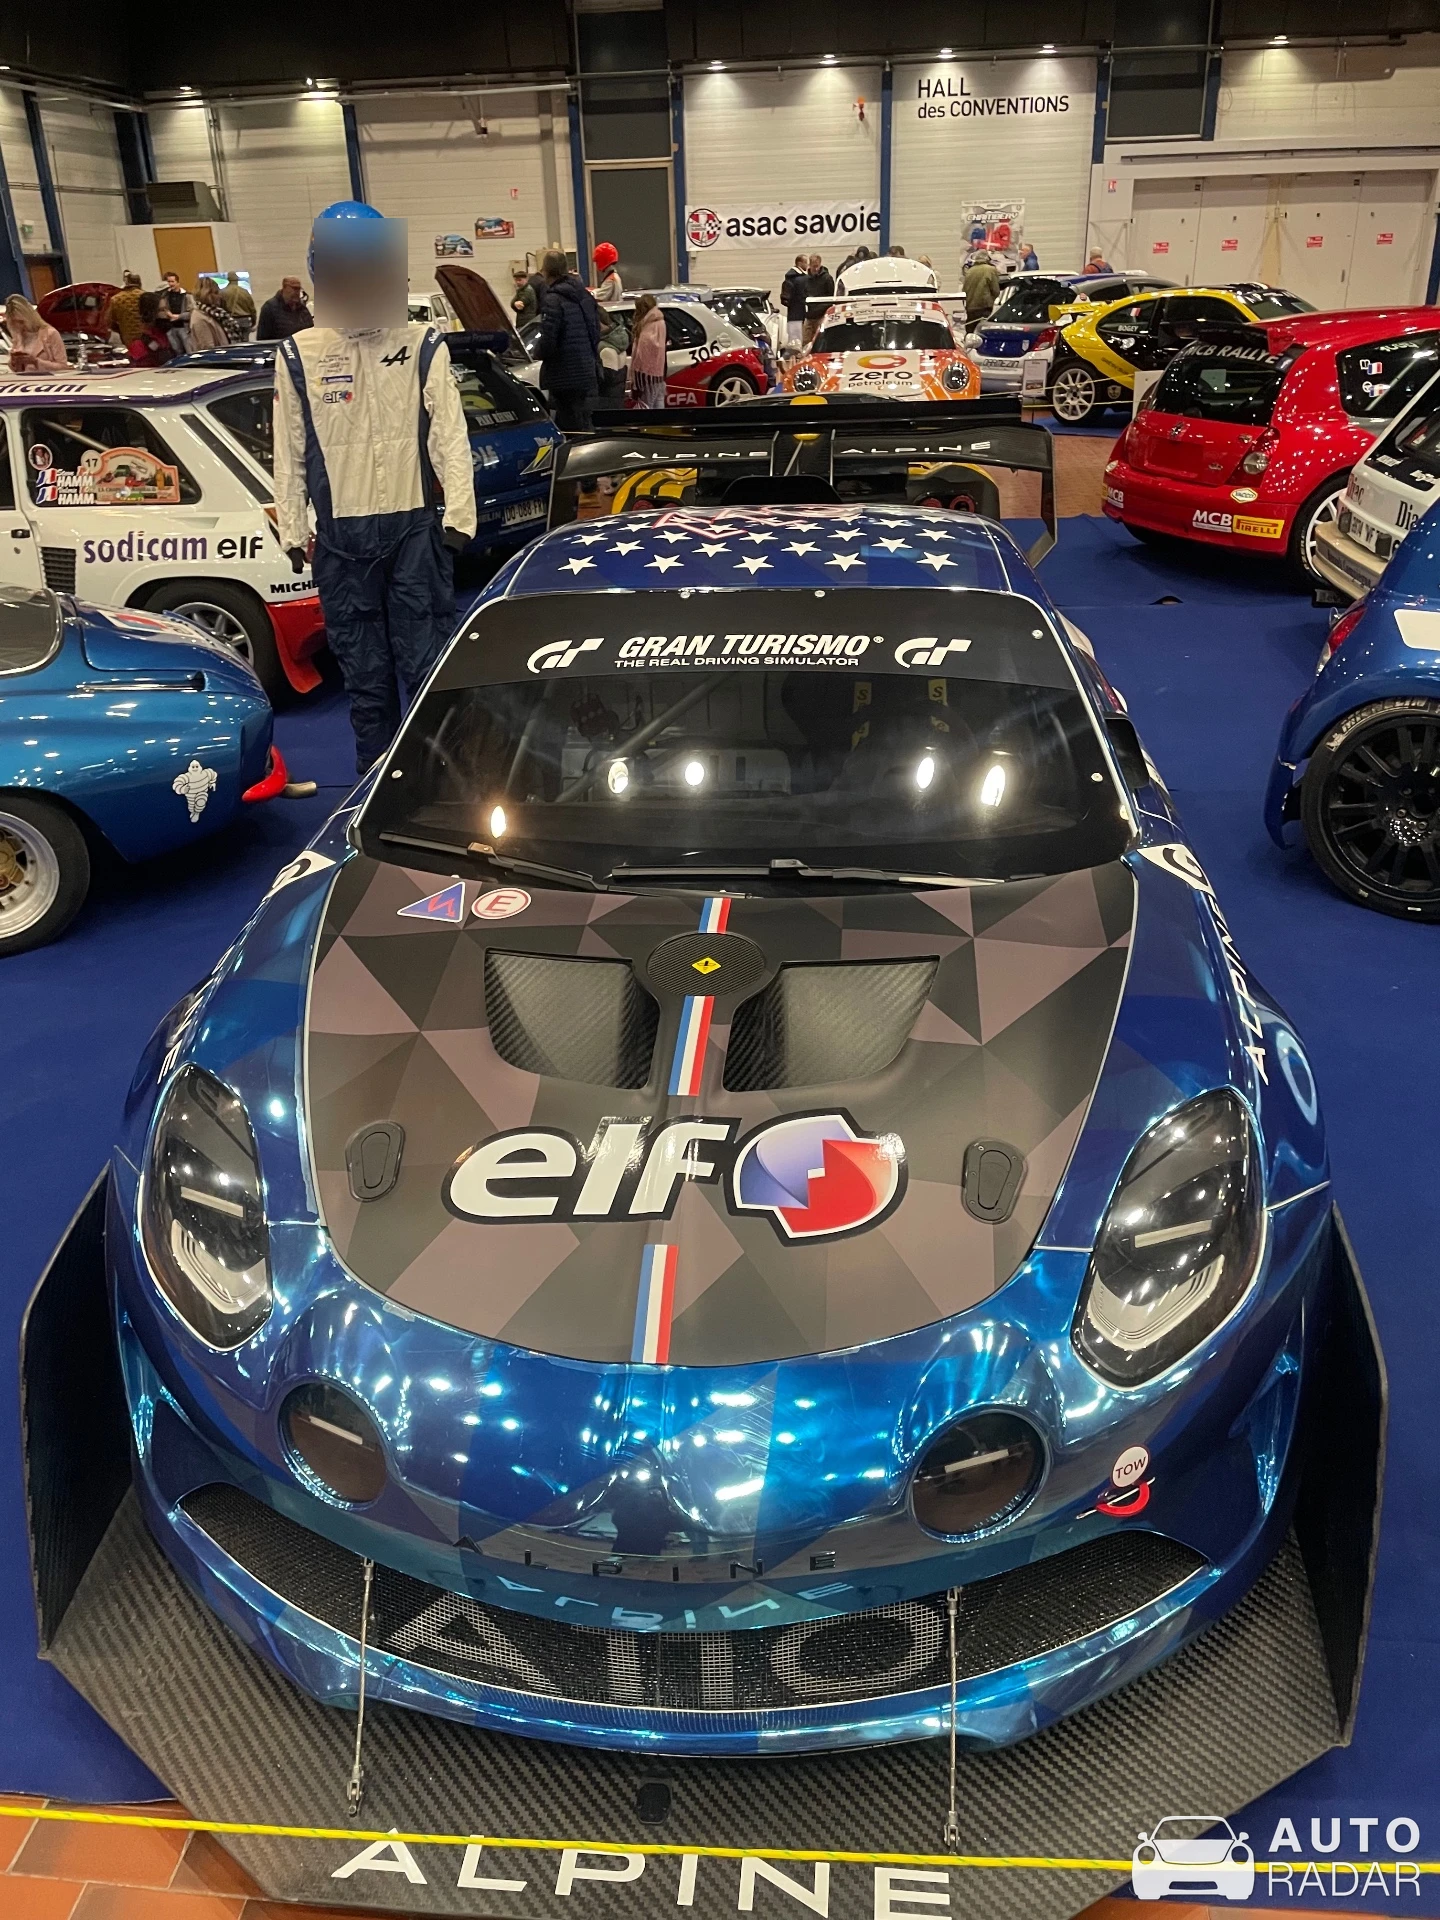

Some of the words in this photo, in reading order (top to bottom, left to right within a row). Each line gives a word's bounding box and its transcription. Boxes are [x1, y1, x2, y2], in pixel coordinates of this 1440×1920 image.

[917, 77, 971, 98] HALL
[918, 102, 946, 118] des
[950, 95, 1070, 117] CONVENTIONS
[725, 216, 787, 237] asac
[794, 205, 880, 235] savoie
[688, 340, 720, 369] 306
[1216, 345, 1284, 364] RALLYE
[848, 371, 913, 382] zero
[848, 380, 913, 388] petroleum
[322, 390, 341, 404] elf
[666, 392, 698, 406] CFA
[85, 458, 98, 468] 17
[622, 451, 768, 459] ALPINE
[57, 475, 93, 488] HAMM
[57, 493, 95, 505] HAMM
[1106, 486, 1124, 503] MCB
[1192, 510, 1232, 527] MCB
[1236, 519, 1279, 535] PIRELLI
[83, 531, 208, 564] sodicam
[216, 536, 264, 559] elf
[618, 634, 715, 659] GRAN
[614, 660, 645, 668] THE
[649, 658, 690, 667] REAL
[694, 657, 759, 667] DRIVING
[764, 656, 859, 666] SIMULATOR
[485, 895, 517, 912] E
[448, 1121, 731, 1218] elf
[1115, 1456, 1147, 1479] TOW
[453, 1535, 838, 1582] ALPINE
[330, 1828, 953, 1920] ALPINE
